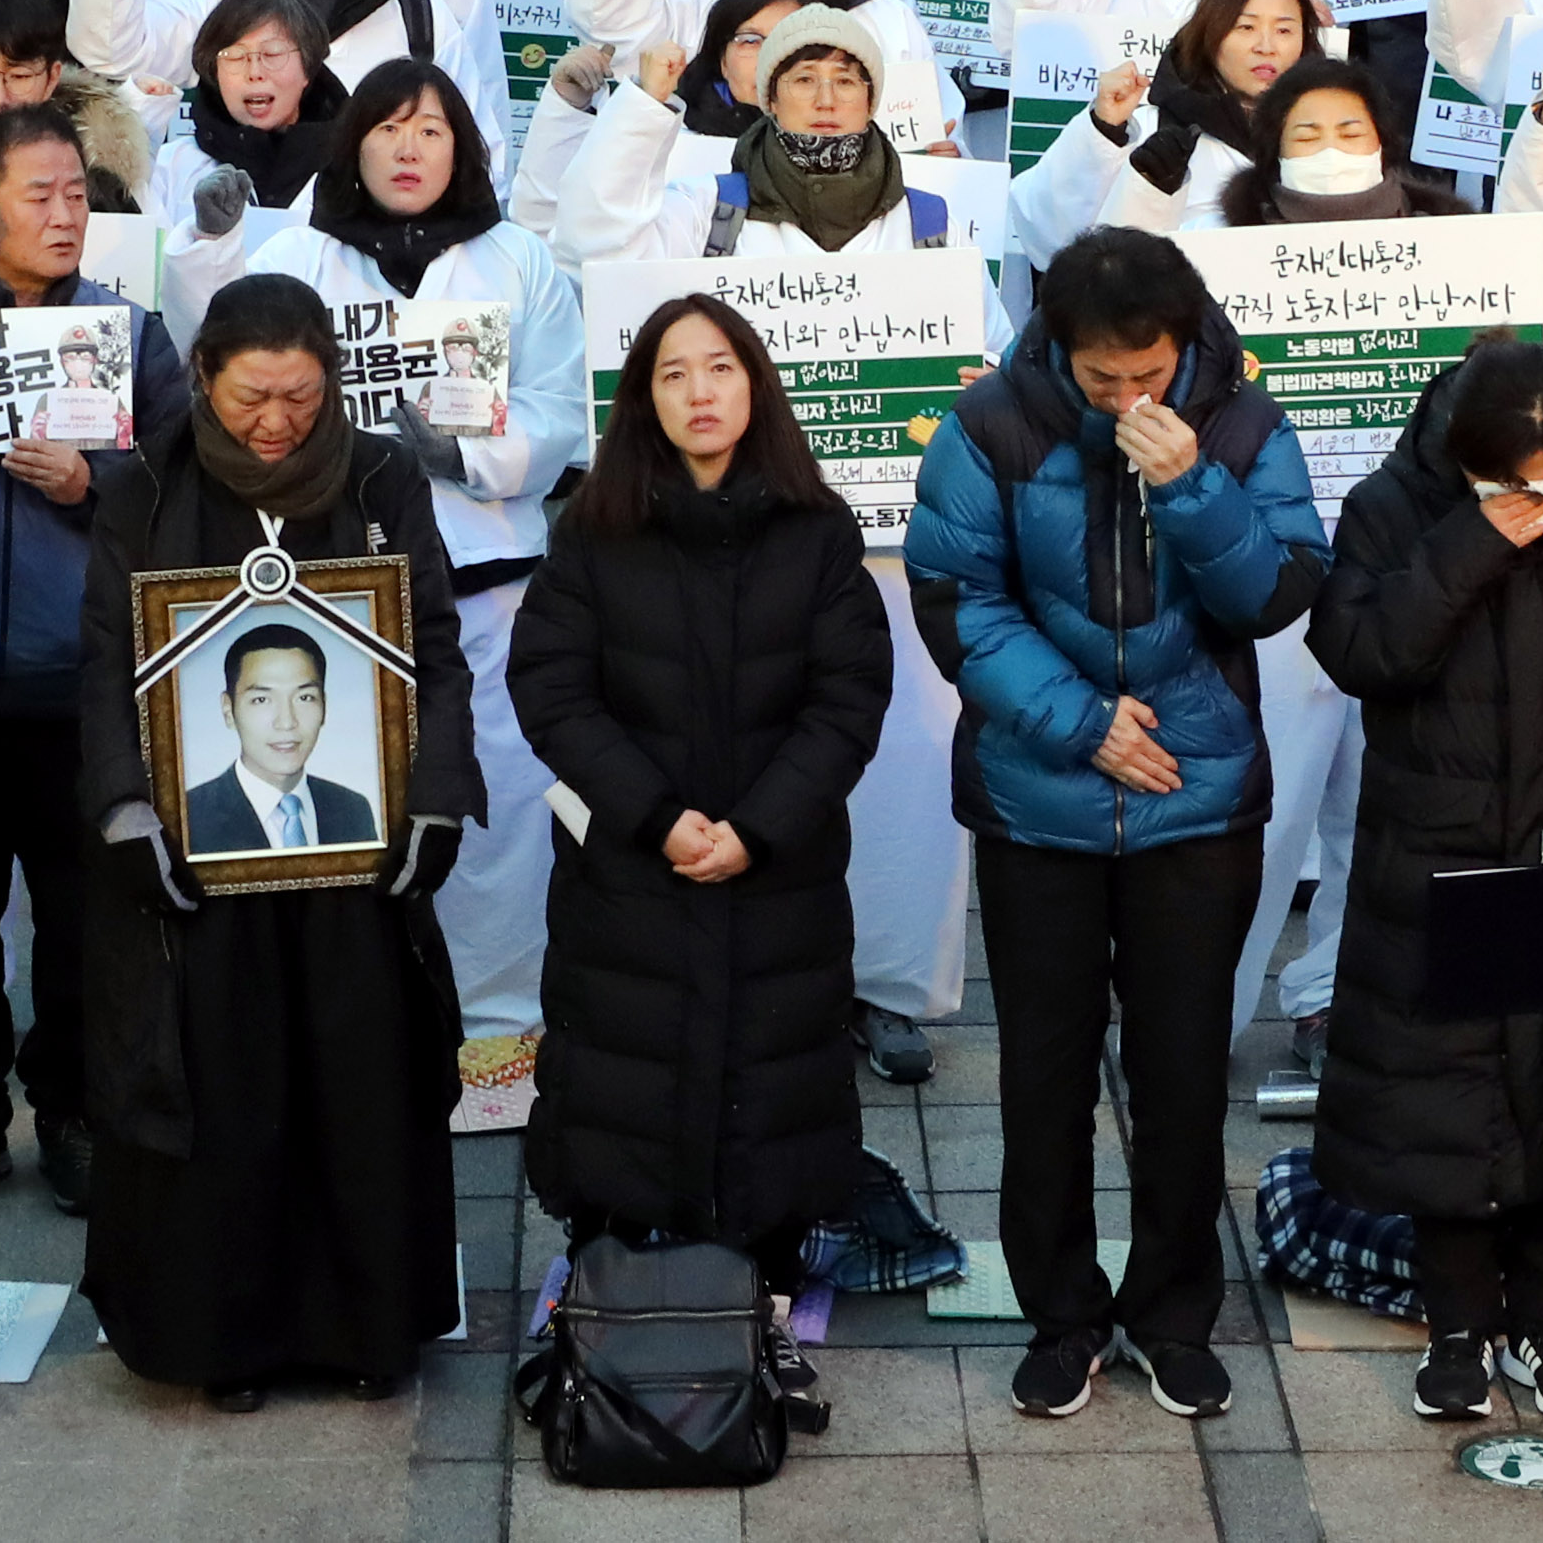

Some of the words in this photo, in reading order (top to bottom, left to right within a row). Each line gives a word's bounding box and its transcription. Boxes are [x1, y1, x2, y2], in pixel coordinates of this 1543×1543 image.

[494, 0, 562, 37] 비정규직
[1435, 104, 1453, 120] 나
[1269, 239, 1423, 280] 문재인대통령.
[711, 271, 862, 312] 문재인대통령.
[1284, 289, 1387, 324] 노동자와
[1398, 282, 1517, 322] 만납시다
[329, 298, 400, 343] 내가
[837, 314, 956, 355] 만납시다
[1285, 334, 1355, 359] 노동악법
[1358, 329, 1419, 354] 없애고!
[799, 361, 859, 387] 없애고!
[1265, 367, 1386, 394] 불법파견책임자
[829, 393, 882, 421] 혼내고!
